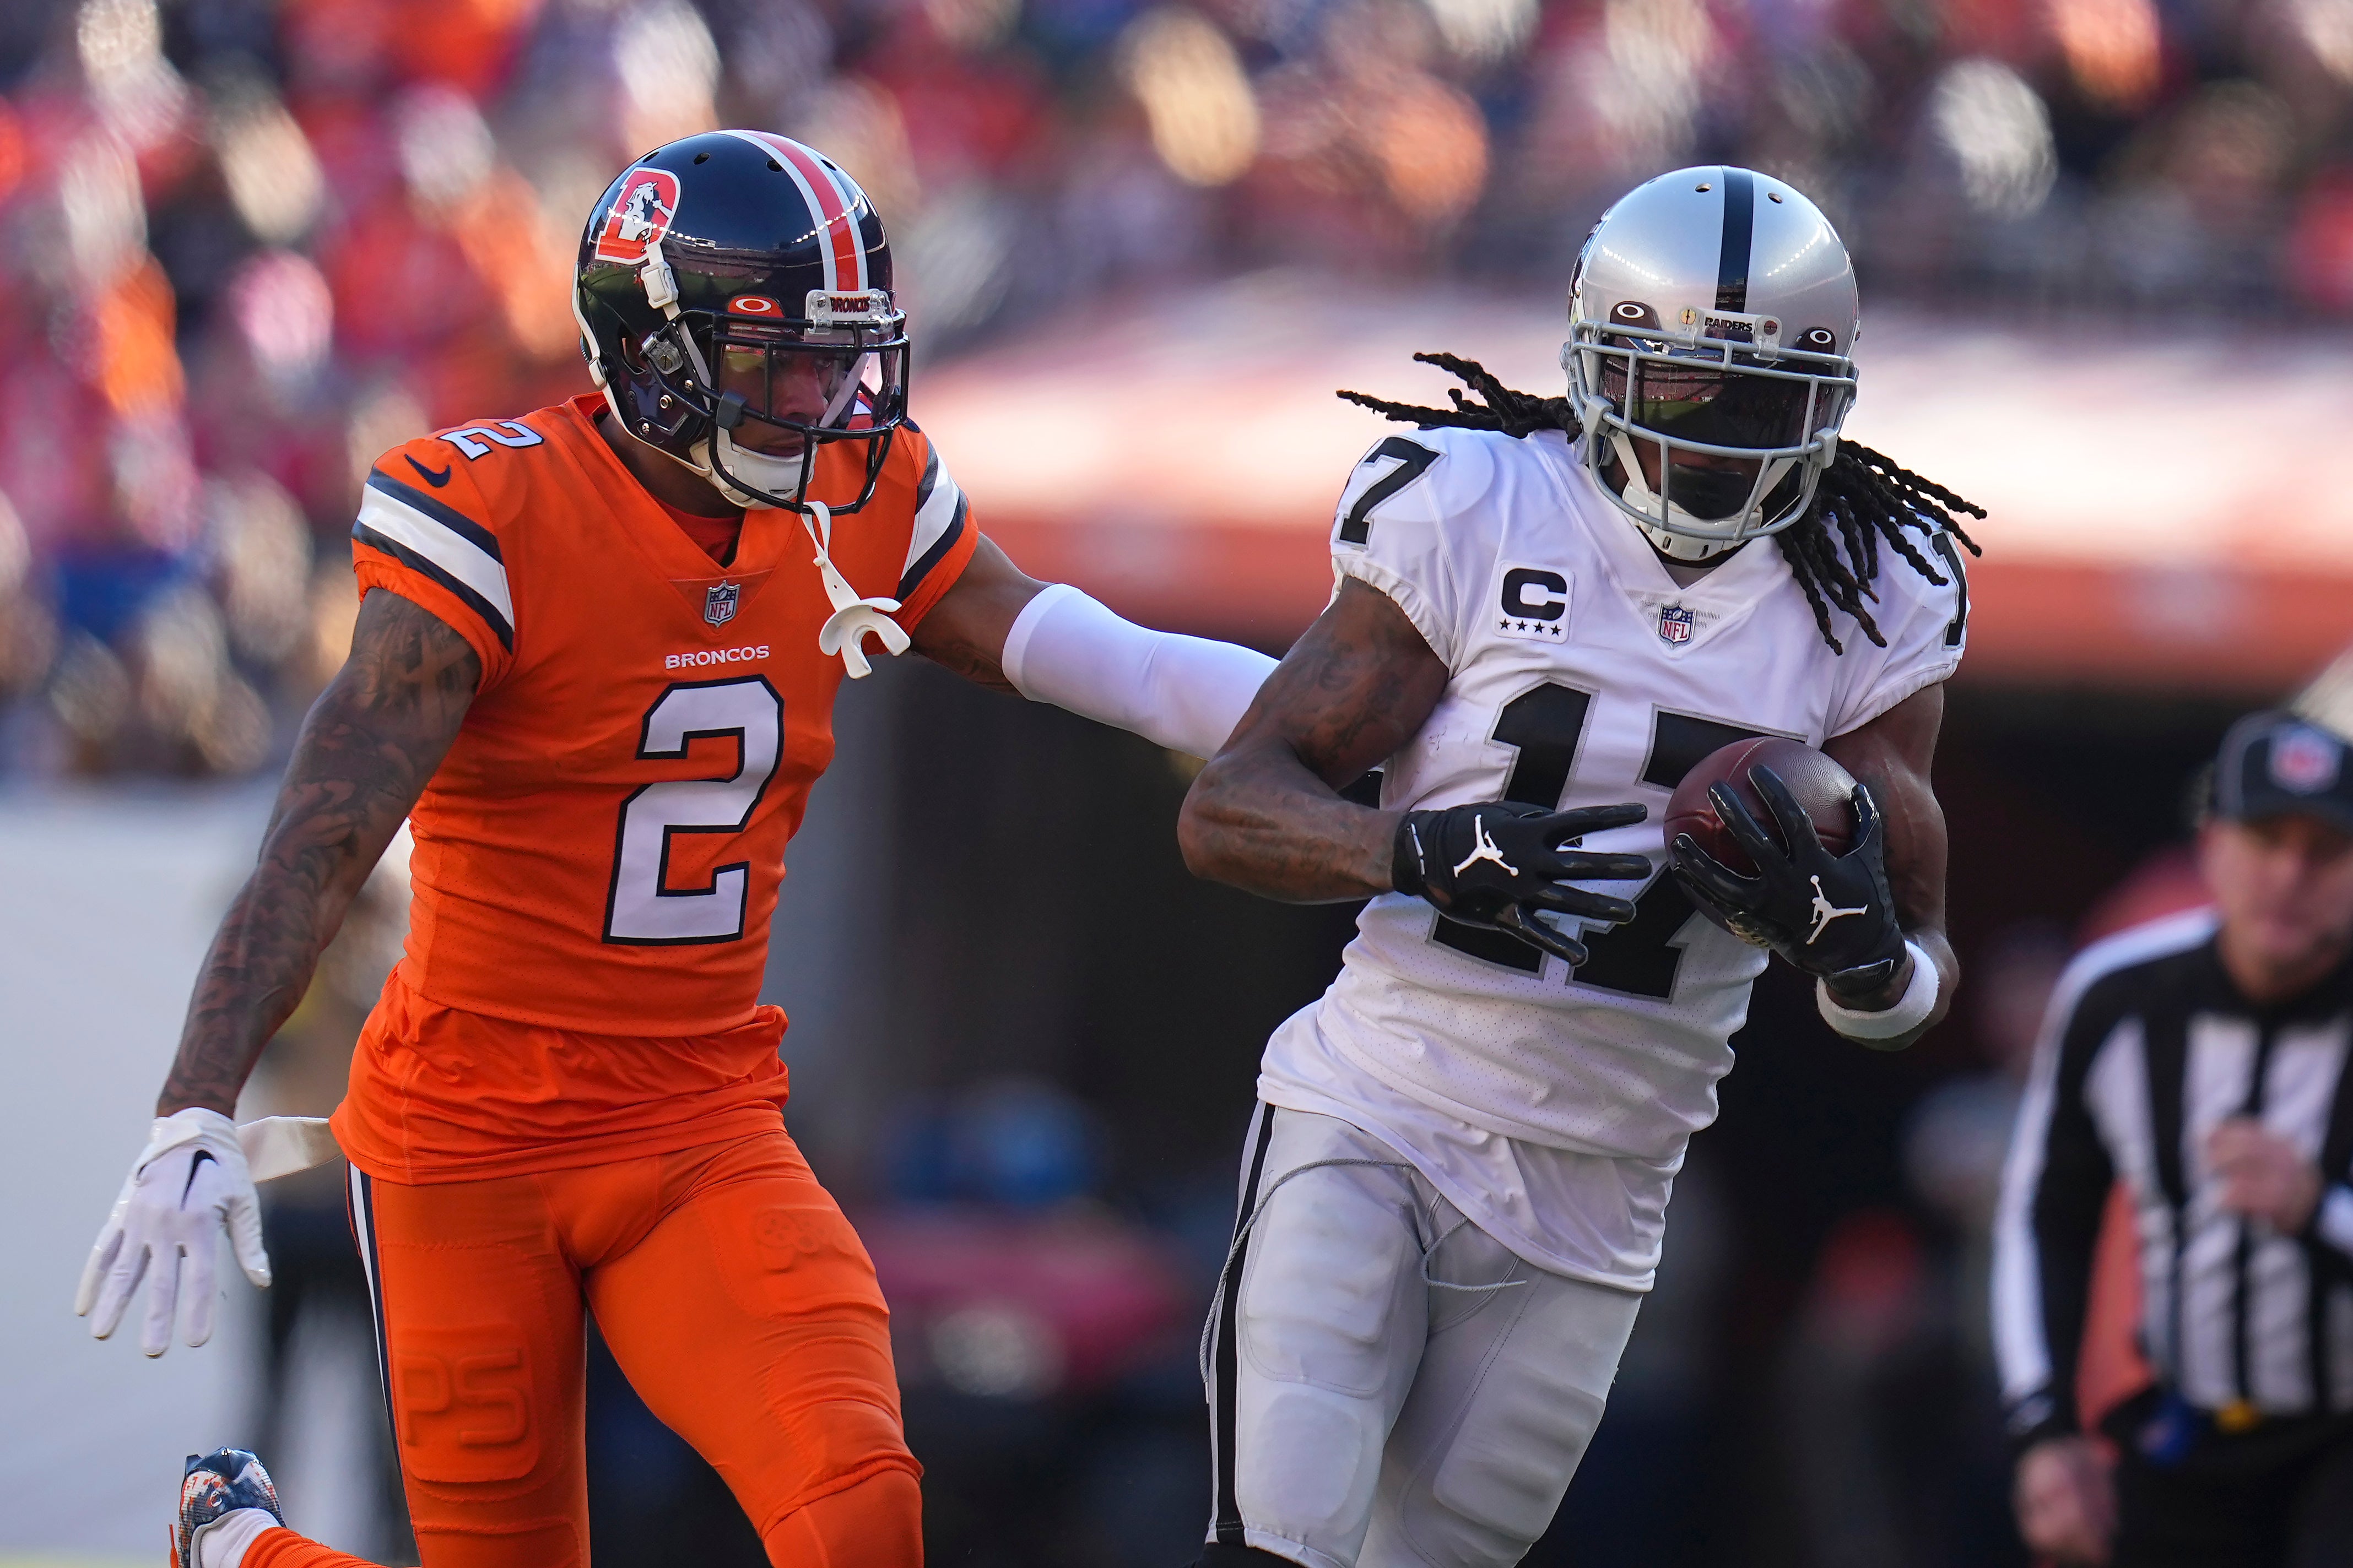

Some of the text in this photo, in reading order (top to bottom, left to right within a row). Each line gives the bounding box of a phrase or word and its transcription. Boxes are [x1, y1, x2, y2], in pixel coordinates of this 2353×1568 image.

[1705, 317, 1753, 332] RAIDERS
[436, 421, 544, 462] 2
[1334, 435, 1448, 551] 7
[709, 601, 732, 619] NFL
[1501, 568, 1567, 621] C
[1662, 620, 1687, 640] NFL
[665, 645, 770, 669] BRONCOS
[603, 674, 785, 946] 2
